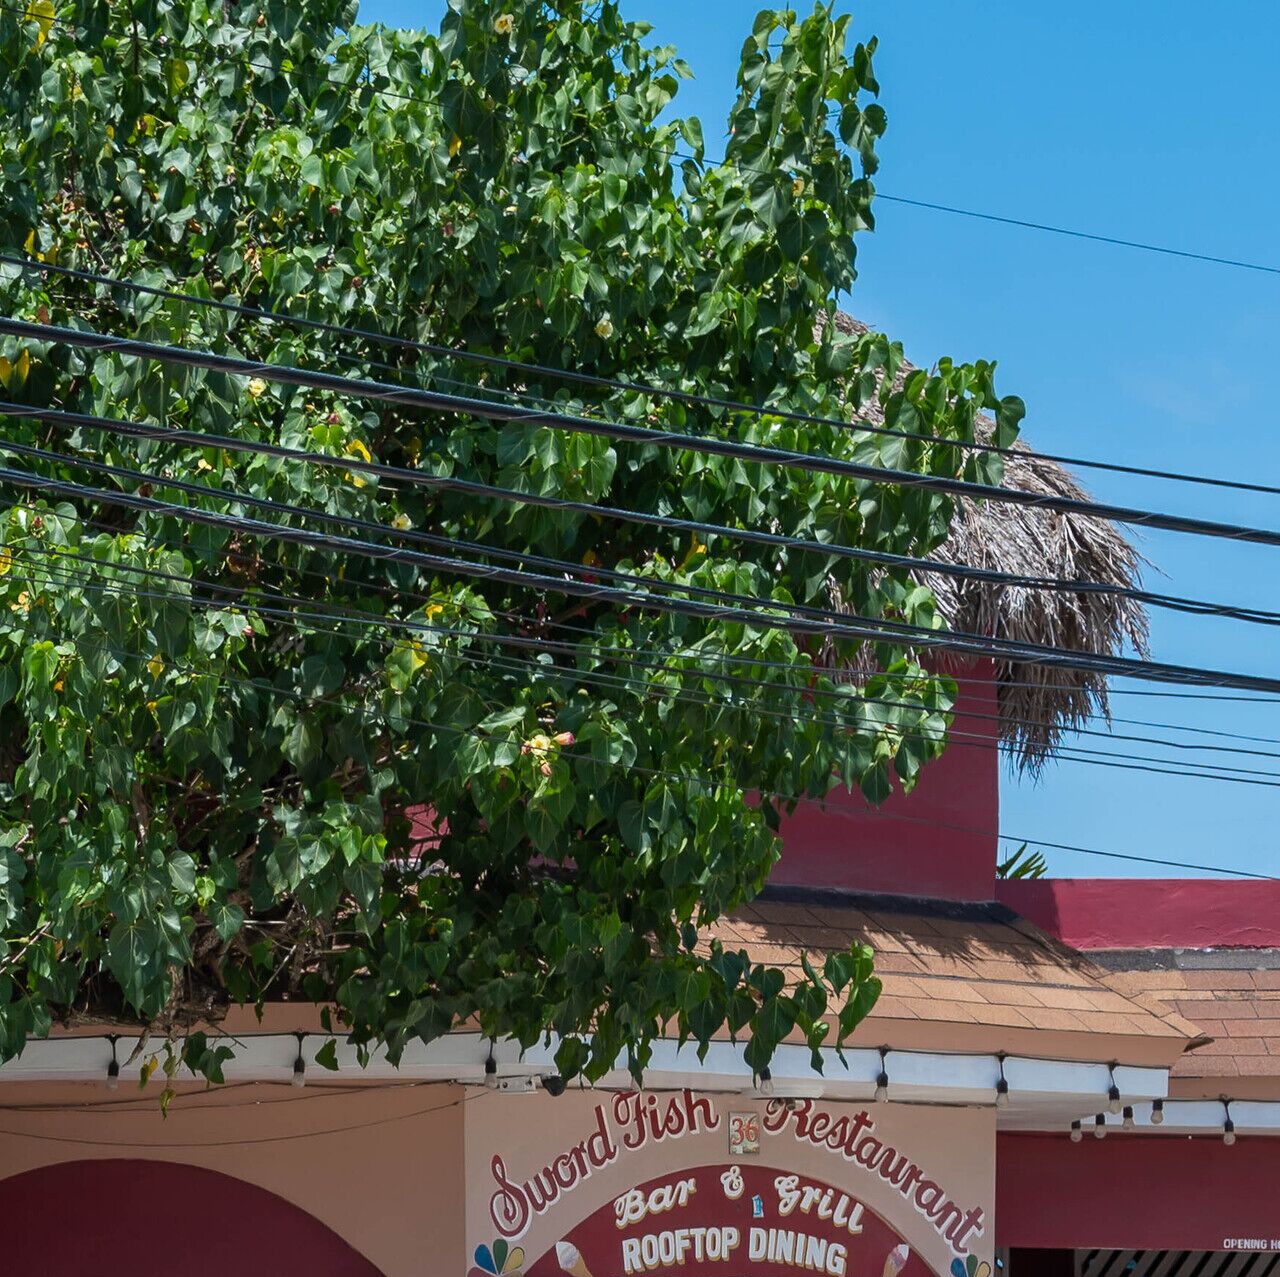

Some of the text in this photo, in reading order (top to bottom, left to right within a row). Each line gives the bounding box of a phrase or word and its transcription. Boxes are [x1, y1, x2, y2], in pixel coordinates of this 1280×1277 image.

[731, 1113, 759, 1146] 36
[490, 1088, 985, 1255] Sword Fish Restaurant
[613, 1177, 697, 1229] Bar
[720, 1165, 745, 1199] &
[774, 1175, 864, 1235] Grill
[622, 1226, 740, 1276] ROOFTOP
[1223, 1238, 1268, 1250] OPENING
